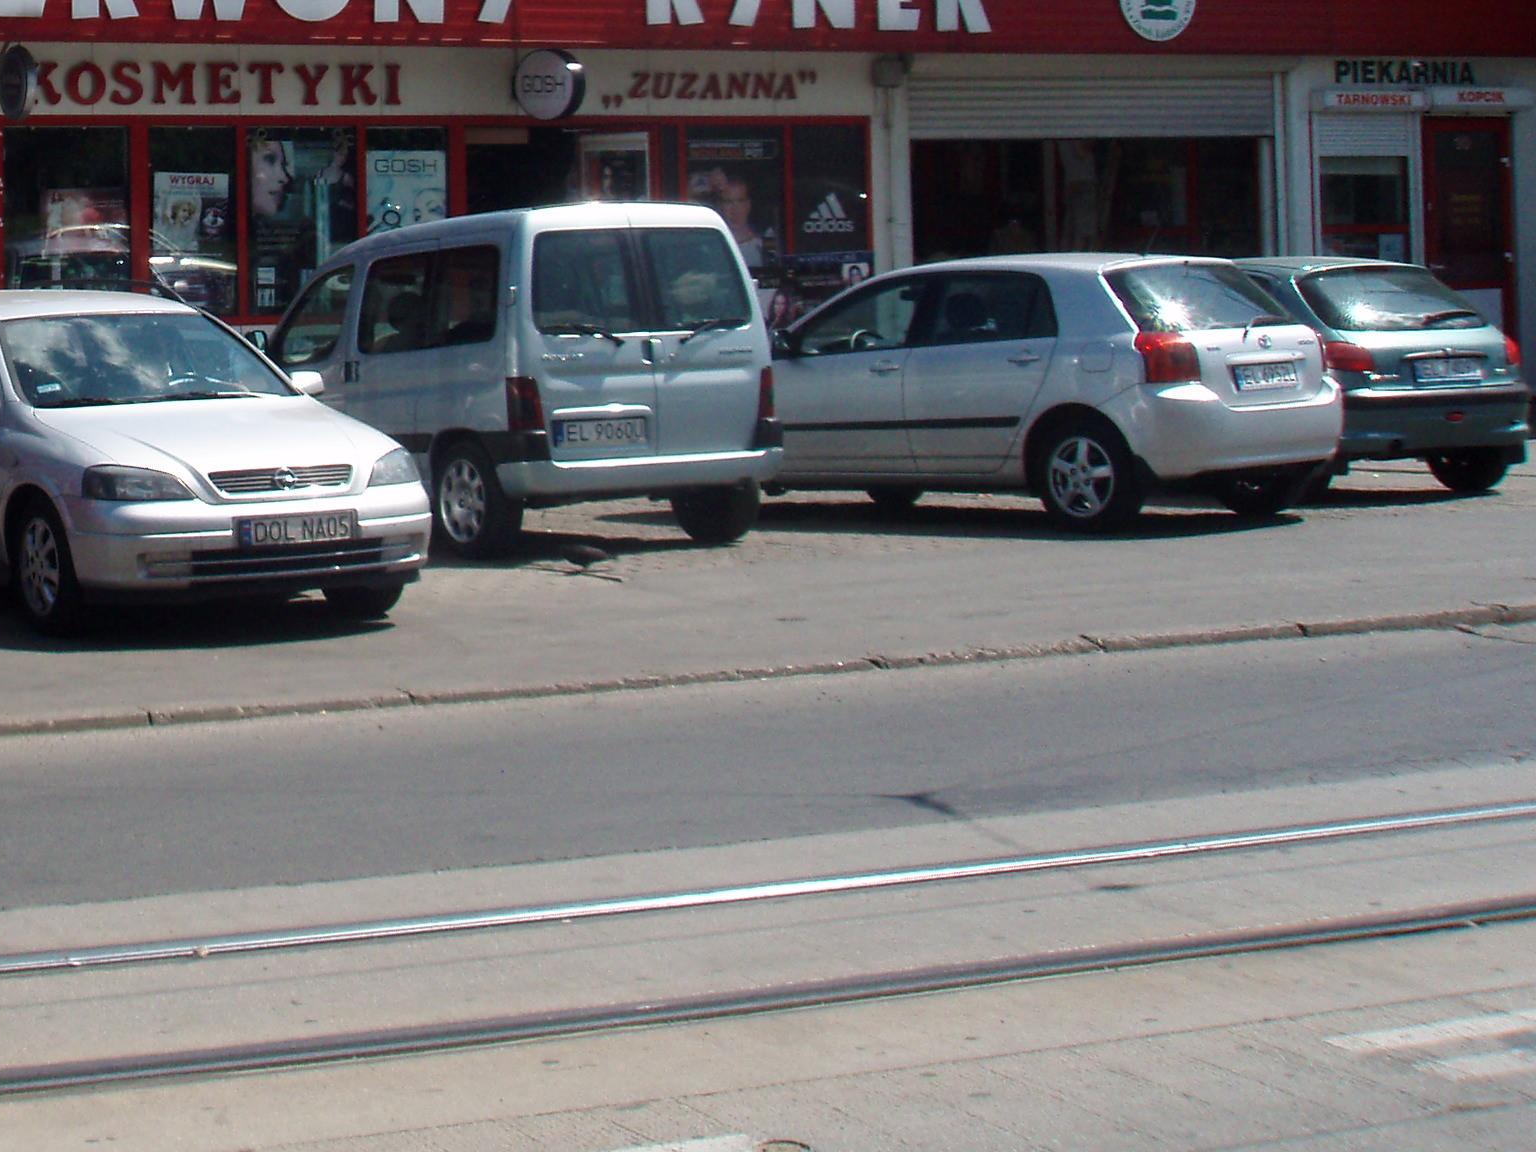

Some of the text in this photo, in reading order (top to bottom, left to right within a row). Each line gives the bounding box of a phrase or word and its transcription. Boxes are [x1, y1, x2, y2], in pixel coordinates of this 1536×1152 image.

[1334, 60, 1476, 85] PIEKARNIA
[34, 61, 402, 106] KOSMETYKI
[374, 159, 438, 173] GOSH
[169, 175, 215, 186] WYGRAJ
[803, 217, 855, 233] adidas
[567, 424, 589, 442] EL
[254, 515, 349, 543] DOL NA05
